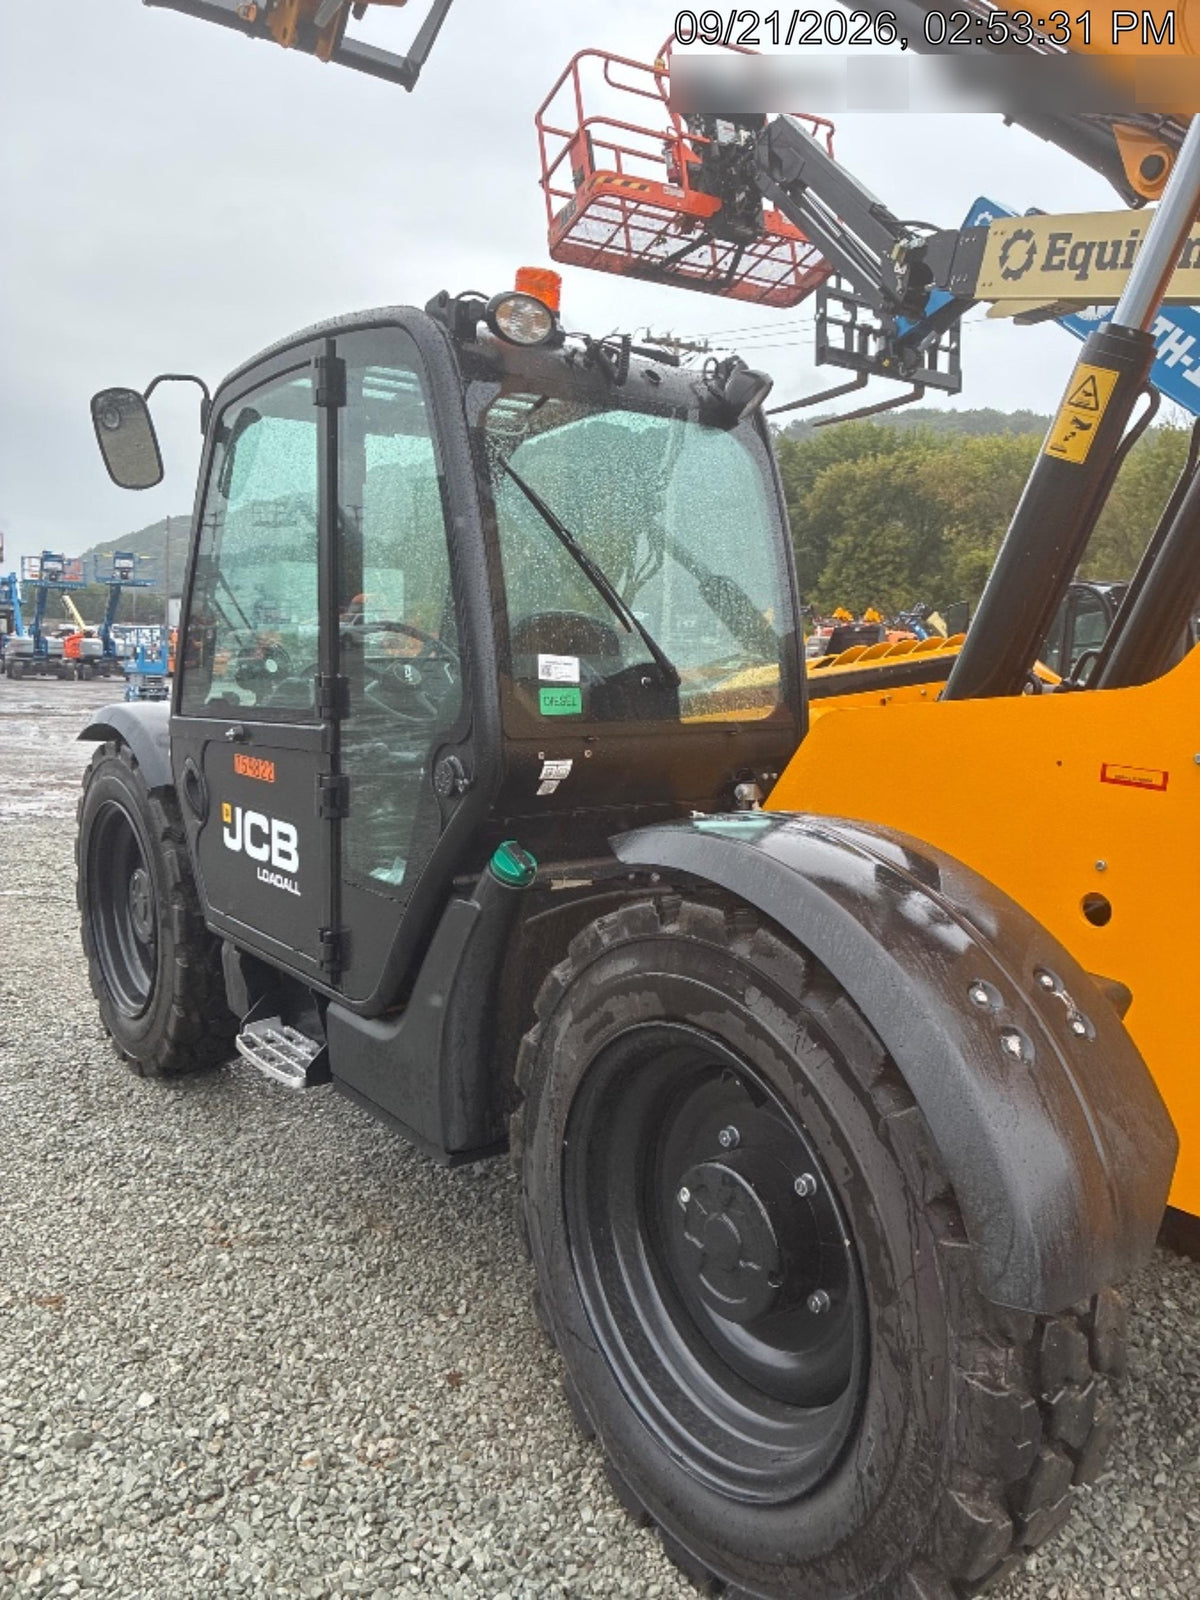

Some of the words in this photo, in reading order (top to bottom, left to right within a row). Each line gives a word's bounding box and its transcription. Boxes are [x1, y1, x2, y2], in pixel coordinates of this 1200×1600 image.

[1040, 228, 1200, 282] Equi
[543, 694, 578, 707] DIESEL
[222, 802, 300, 873] JCB
[256, 866, 302, 898] LOADALL
